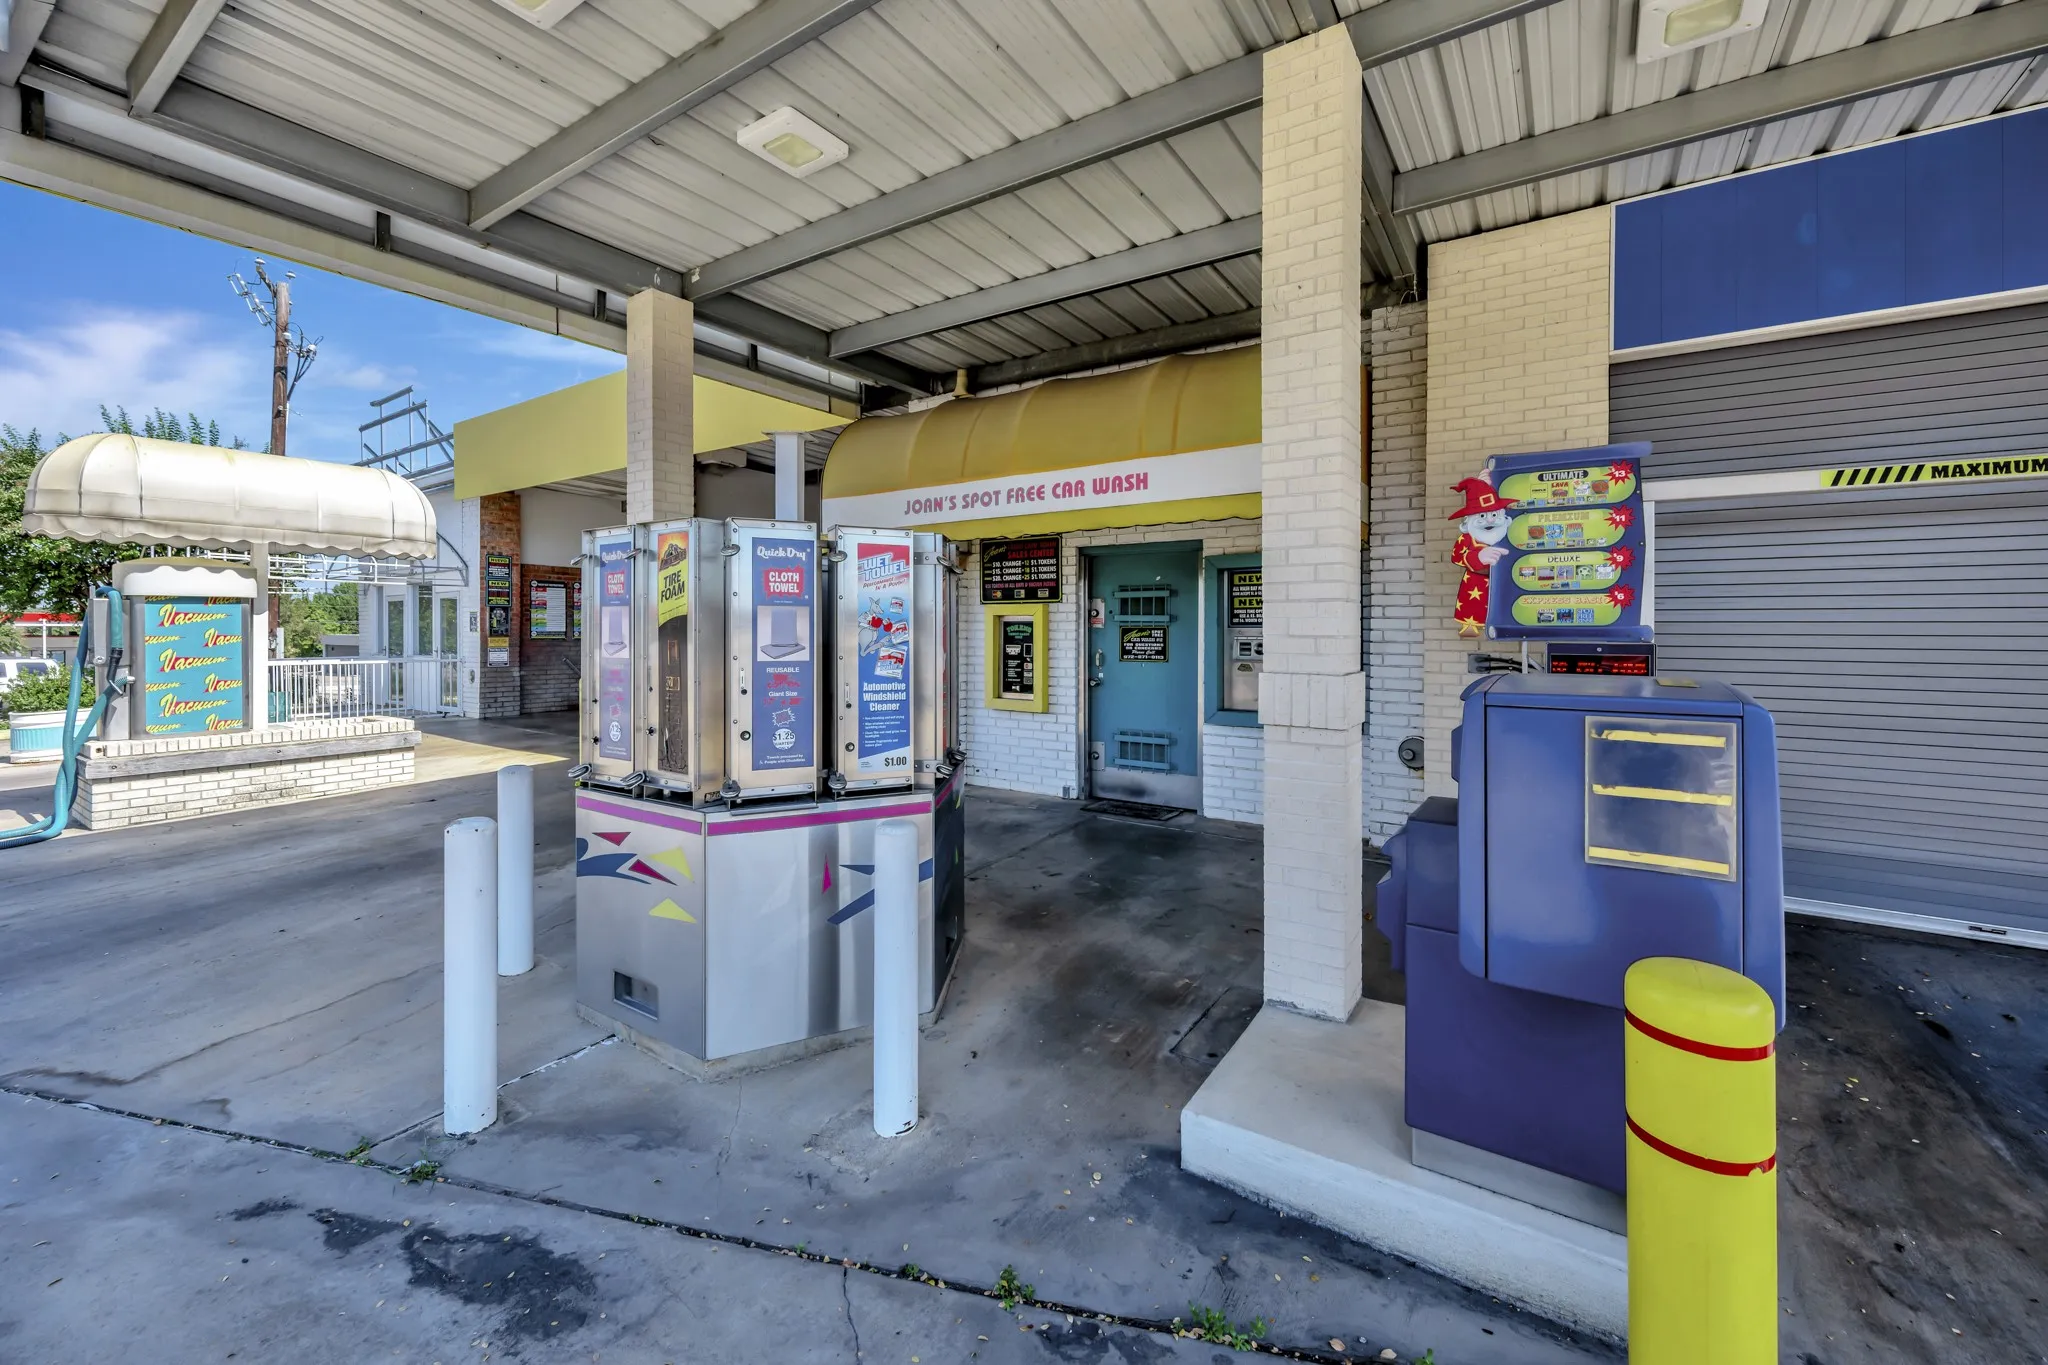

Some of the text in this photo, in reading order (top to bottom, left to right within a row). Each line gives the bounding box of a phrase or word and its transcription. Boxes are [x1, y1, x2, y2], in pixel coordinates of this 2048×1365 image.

[1931, 458, 2048, 479] MAXIMUM
[1542, 470, 1584, 481] ULTIMATE
[904, 471, 1149, 516] JOAN'S SPOT FREE CAR WASH
[861, 552, 892, 570] WET
[1547, 554, 1580, 563] DELUXE
[769, 571, 800, 582] CLOTH
[863, 562, 909, 582] TOWEL
[663, 569, 682, 589] TIRE
[660, 581, 685, 604] FOAM
[769, 582, 800, 593] TOWEL
[1521, 596, 1570, 605] EXPRESS
[159, 604, 227, 628] Vacuum
[159, 648, 228, 673] Vacuum
[863, 682, 906, 692] Automotive
[863, 692, 906, 702] Windshield
[160, 694, 228, 718] Vacuum
[870, 702, 900, 712] Cleaner
[772, 732, 795, 741] $1.25
[884, 756, 907, 767] $1.00
